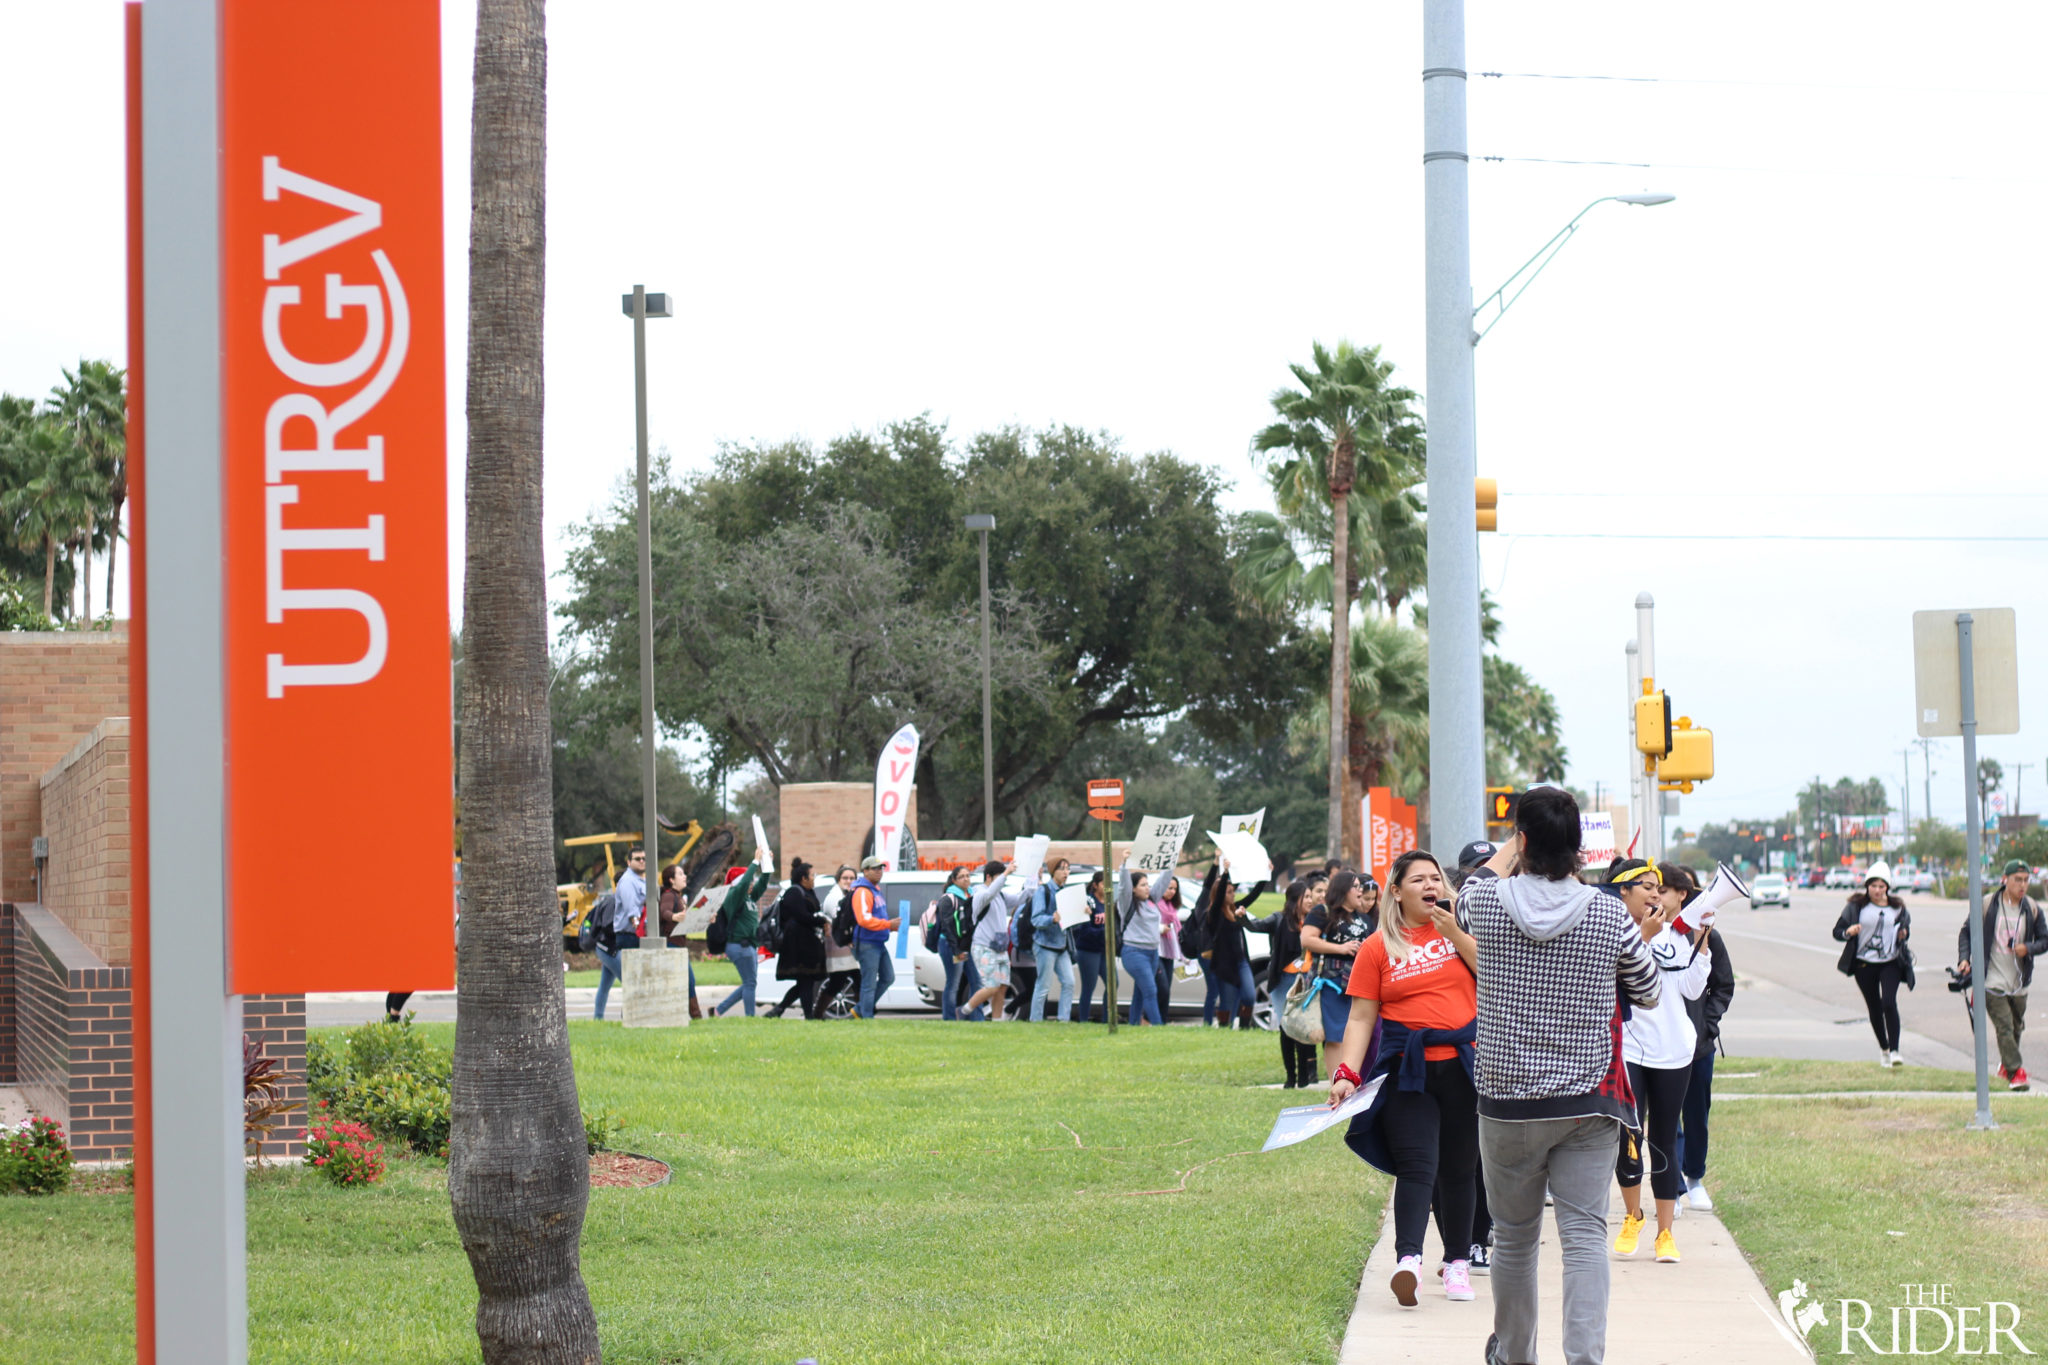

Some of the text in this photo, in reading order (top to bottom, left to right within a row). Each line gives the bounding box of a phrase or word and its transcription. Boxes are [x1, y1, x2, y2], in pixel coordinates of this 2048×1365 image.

[261, 155, 410, 700] UTRGV
[1580, 815, 1612, 831] stamos
[1372, 814, 1388, 866] UTRGV
[1390, 821, 1404, 861] TRGV
[1396, 970, 1421, 981] GENDER
[1422, 963, 1443, 974] EQUITY
[1407, 964, 1421, 972] FOR
